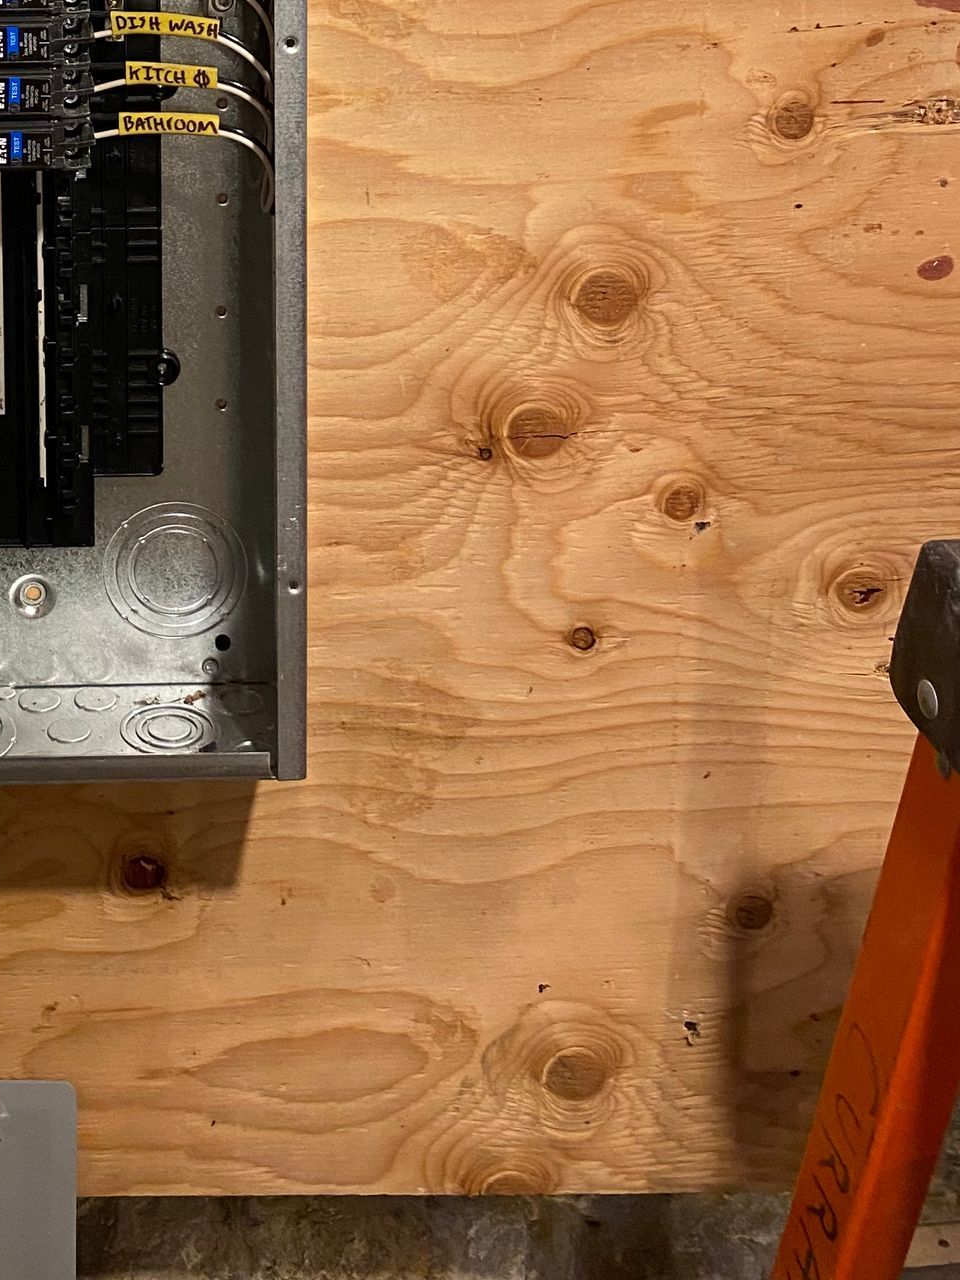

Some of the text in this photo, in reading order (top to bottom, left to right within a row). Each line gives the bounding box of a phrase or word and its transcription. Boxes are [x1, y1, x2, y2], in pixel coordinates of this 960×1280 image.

[115, 15, 219, 39] DISH WASH
[128, 65, 186, 84] KITCH
